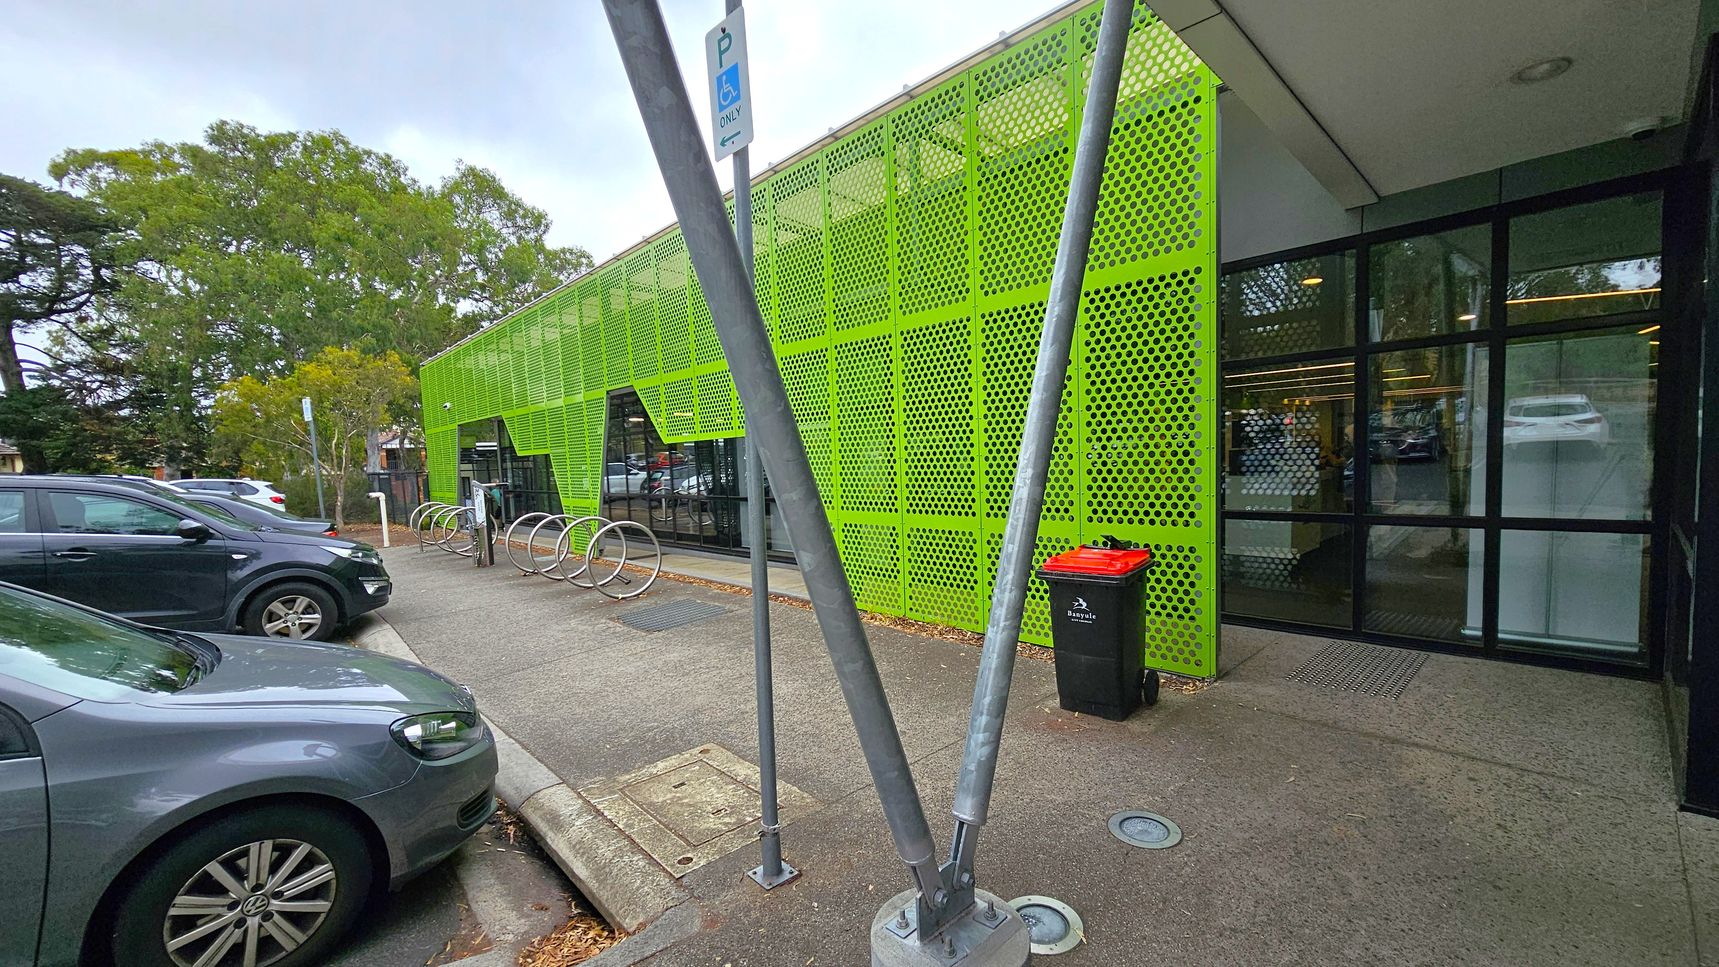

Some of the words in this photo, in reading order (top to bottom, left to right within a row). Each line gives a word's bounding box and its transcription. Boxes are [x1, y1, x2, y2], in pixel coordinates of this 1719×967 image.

[717, 31, 732, 69] P
[719, 105, 742, 128] ONLY
[1067, 610, 1097, 620] Banyule
